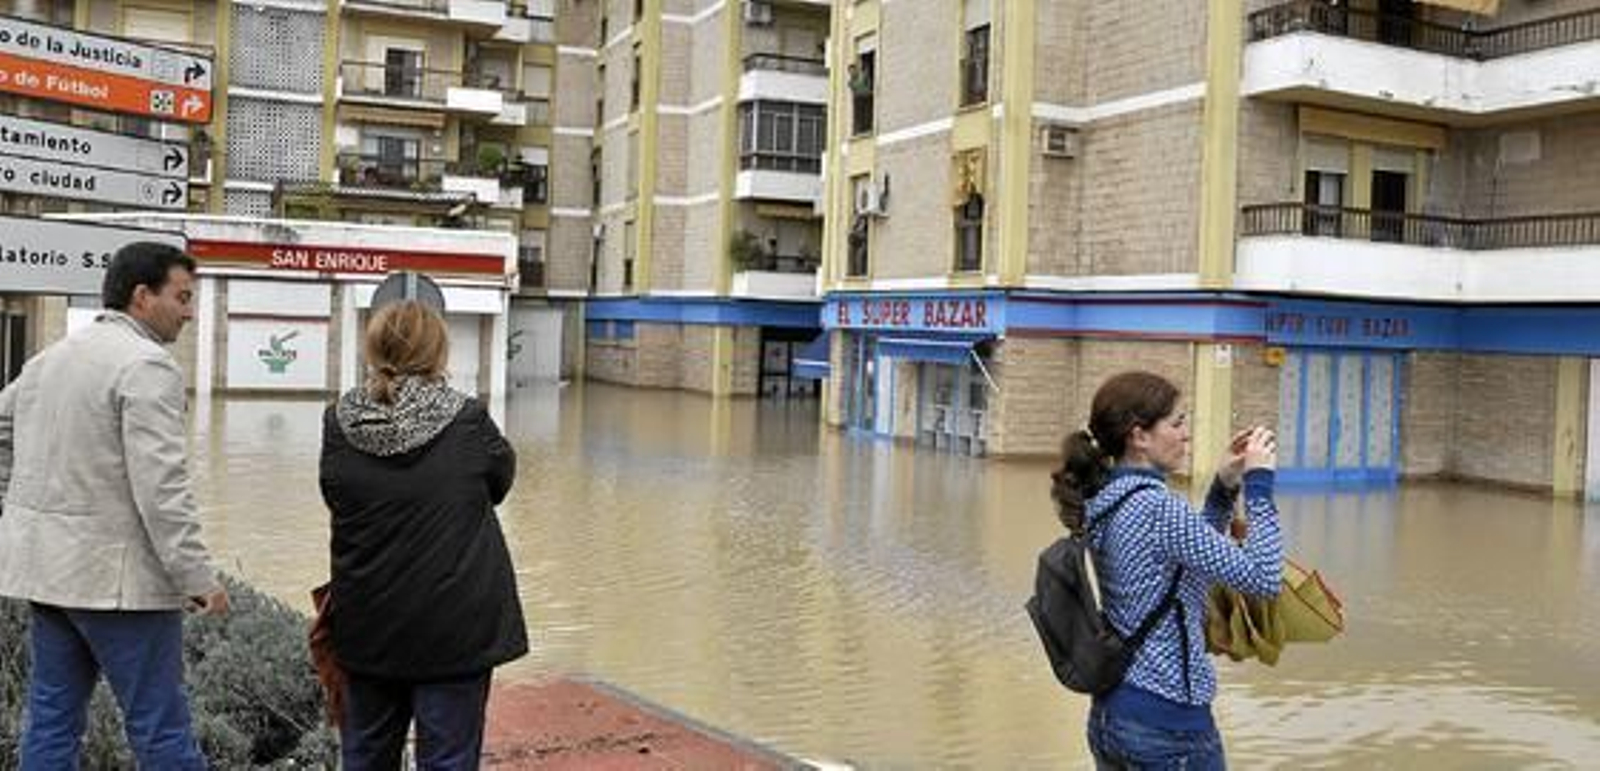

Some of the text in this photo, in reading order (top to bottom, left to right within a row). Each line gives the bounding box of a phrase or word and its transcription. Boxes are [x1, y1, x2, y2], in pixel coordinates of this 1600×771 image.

[16, 30, 40, 48] de
[47, 35, 63, 53] la
[70, 41, 142, 69] Justicia
[15, 70, 40, 88] de
[47, 75, 109, 99] Fútbol
[1, 126, 91, 154] tamiento
[30, 170, 95, 191] ciudad
[272, 250, 388, 271] SAN ENRIQUE
[838, 301, 986, 327] EL SUPER BAZAR
